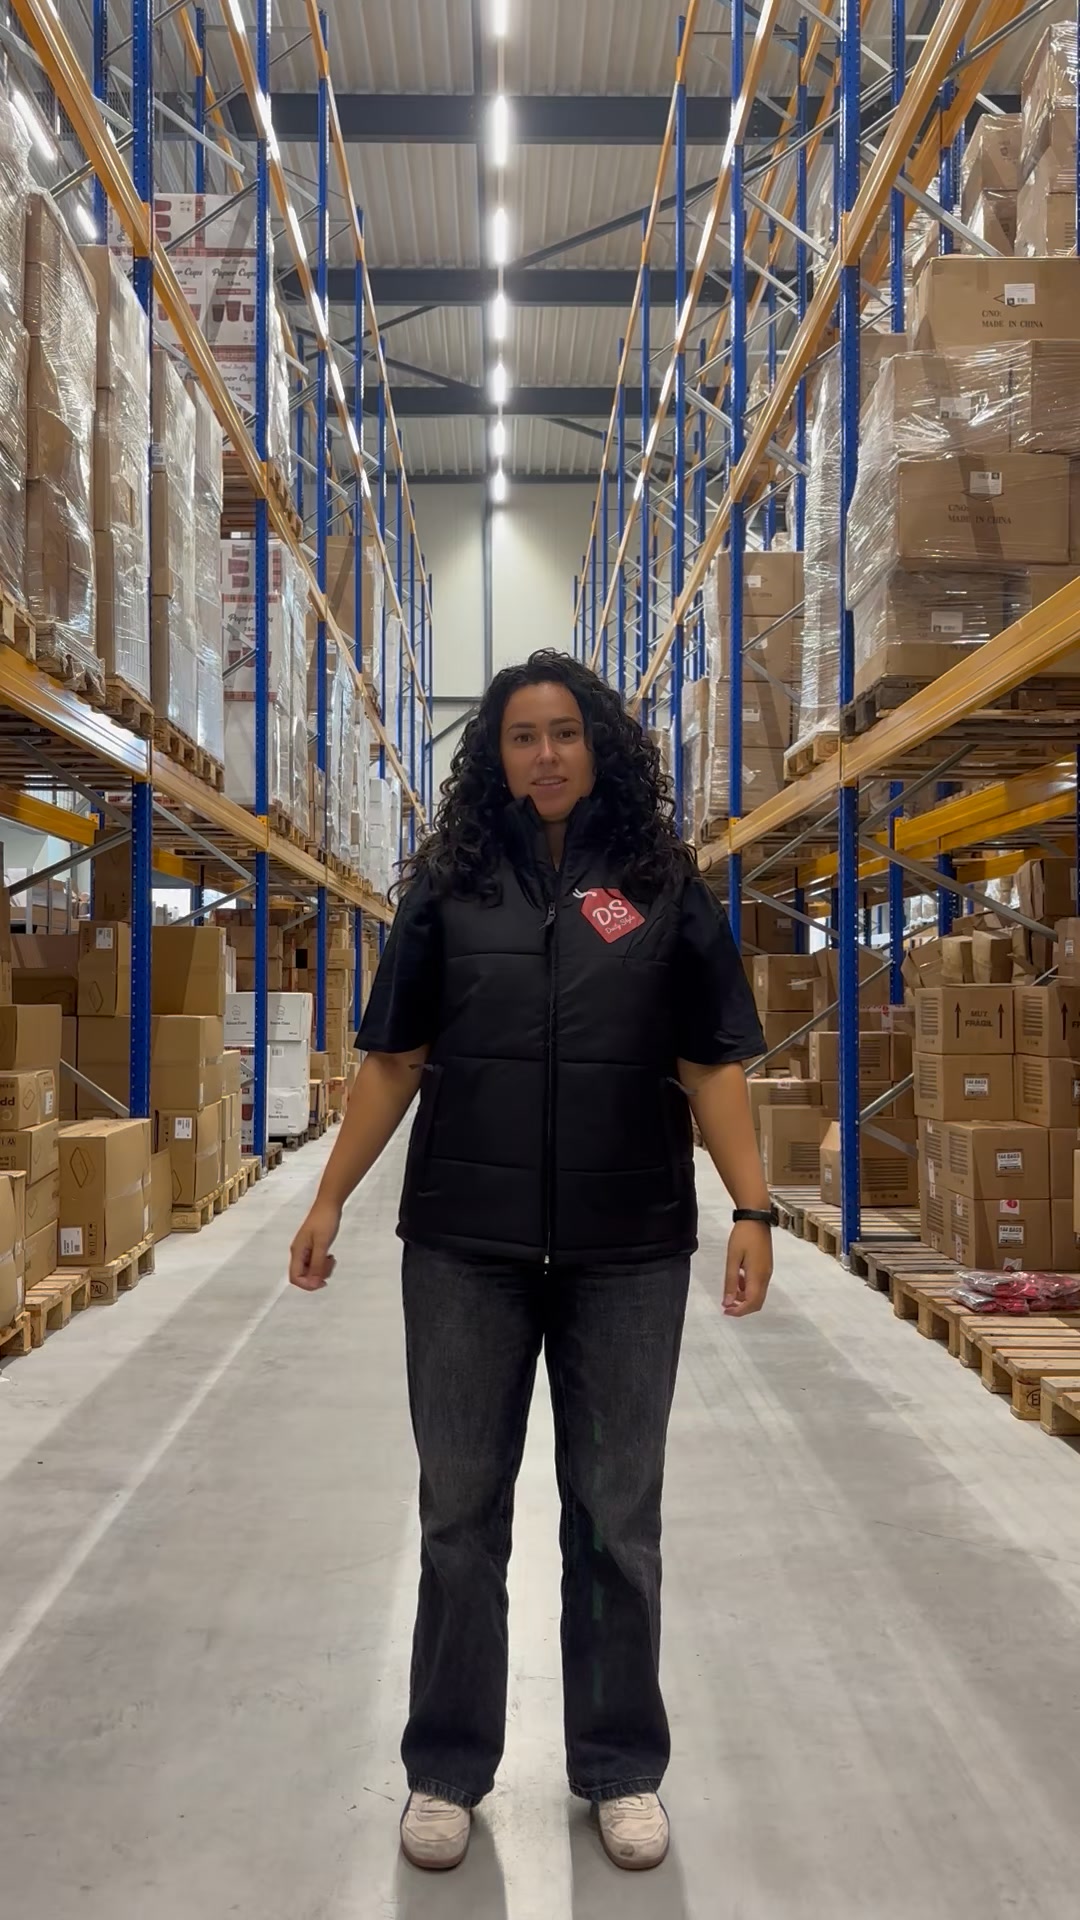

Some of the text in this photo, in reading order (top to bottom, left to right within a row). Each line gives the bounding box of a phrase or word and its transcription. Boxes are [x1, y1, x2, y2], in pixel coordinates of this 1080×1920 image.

[184, 267, 203, 279] Cups
[211, 268, 237, 279] Paper
[228, 613, 253, 624] Paper
[592, 899, 628, 926] DS
